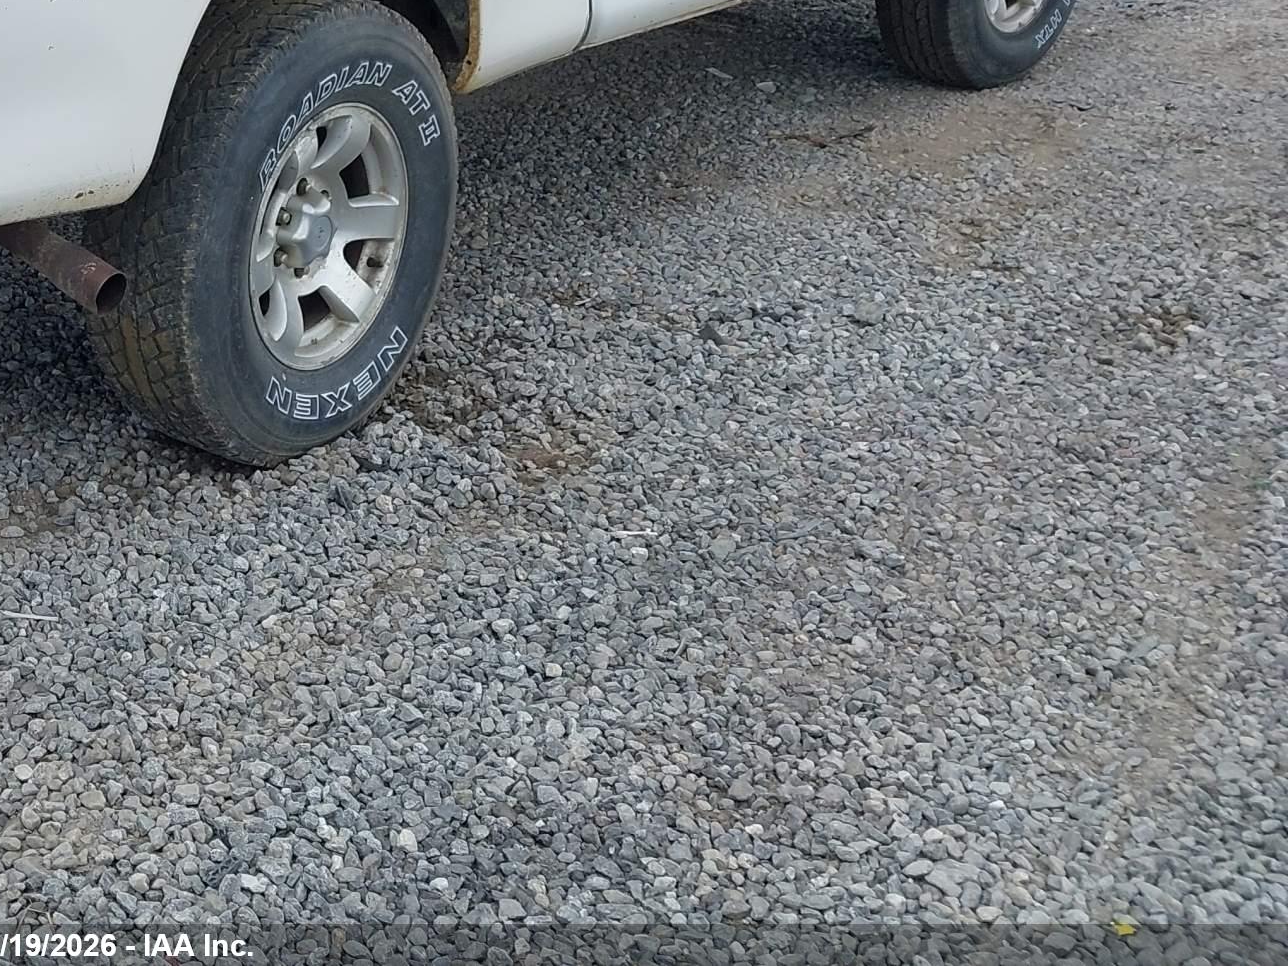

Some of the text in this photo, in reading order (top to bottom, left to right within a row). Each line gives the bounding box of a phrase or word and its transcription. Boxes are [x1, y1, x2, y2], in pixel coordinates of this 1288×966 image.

[259, 62, 392, 190] ROADIAN
[392, 80, 430, 116] AT
[265, 326, 408, 420] NEXEN
